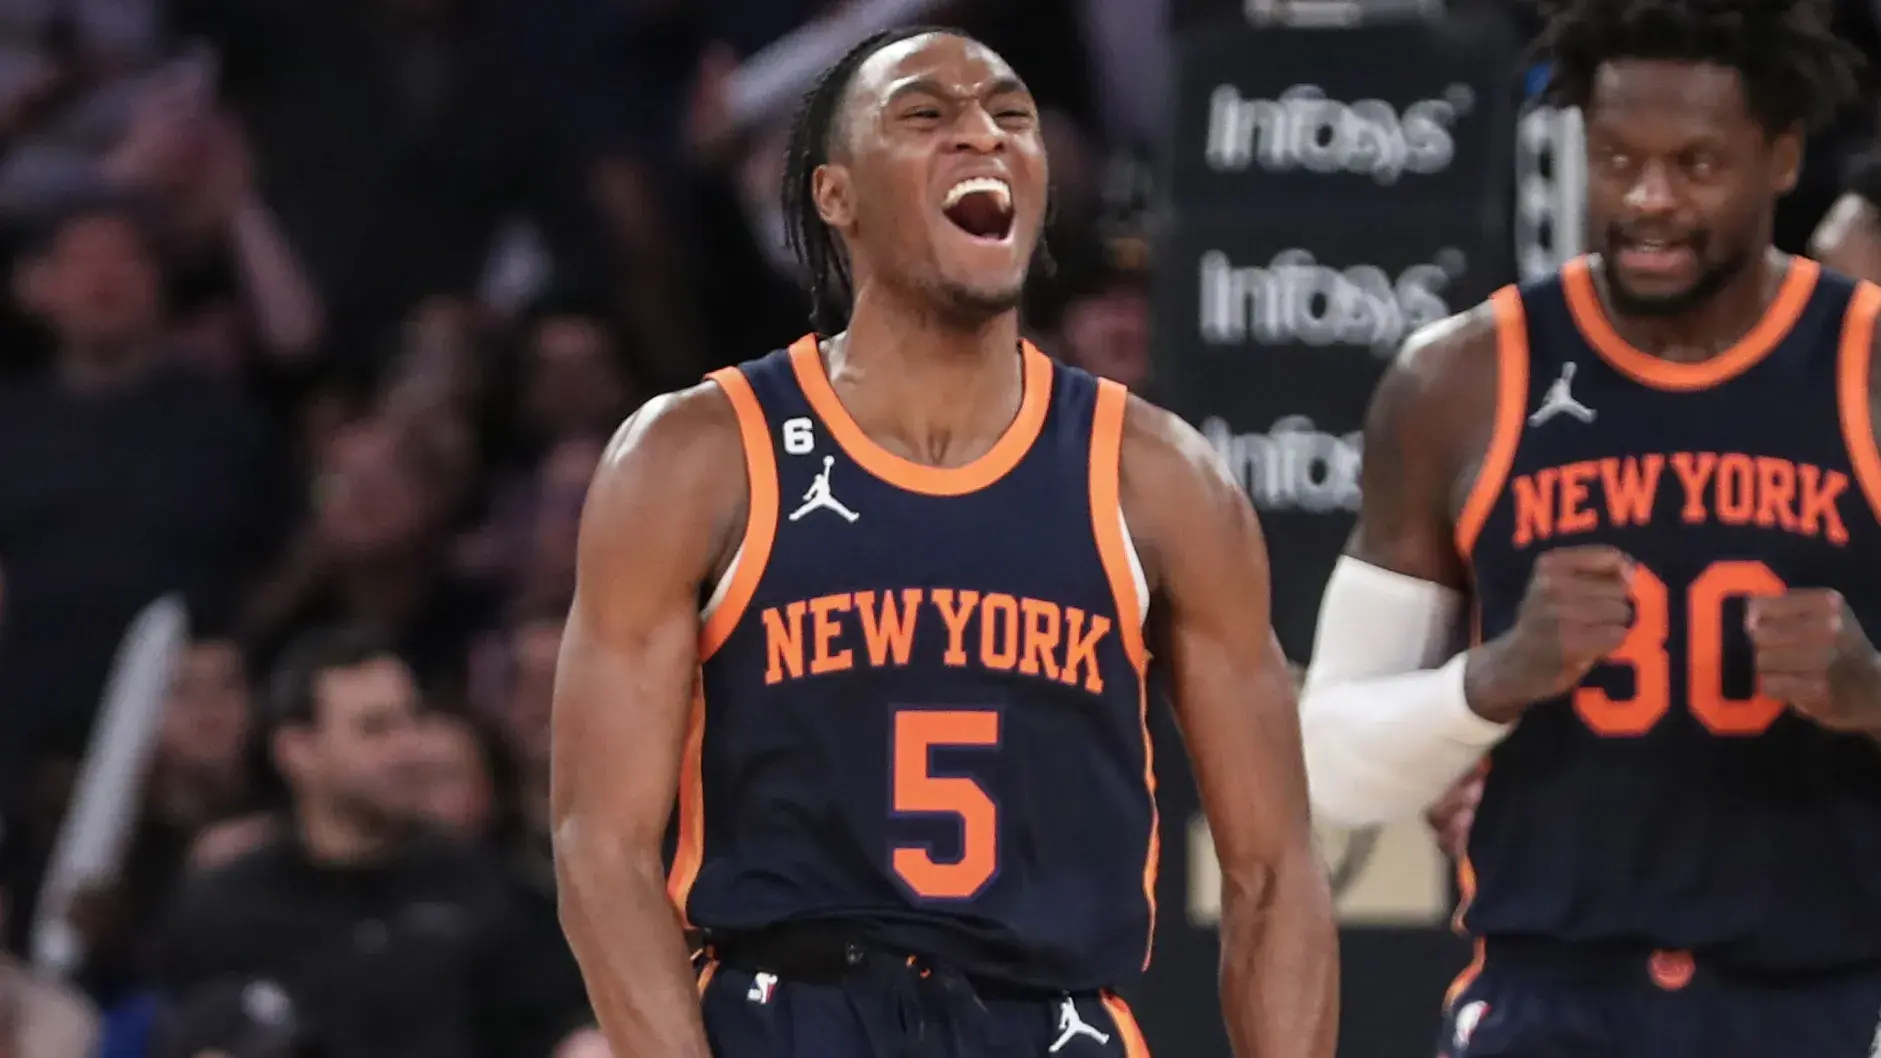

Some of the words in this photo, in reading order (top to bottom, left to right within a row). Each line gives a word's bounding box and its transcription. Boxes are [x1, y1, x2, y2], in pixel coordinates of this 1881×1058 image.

[783, 417, 815, 454] 6
[1514, 454, 1664, 545] NEW
[1671, 452, 1849, 545] YORK
[762, 588, 923, 685] NEW
[931, 588, 1111, 693] YORK
[1573, 560, 1786, 735] 30
[891, 709, 1000, 898] 5
